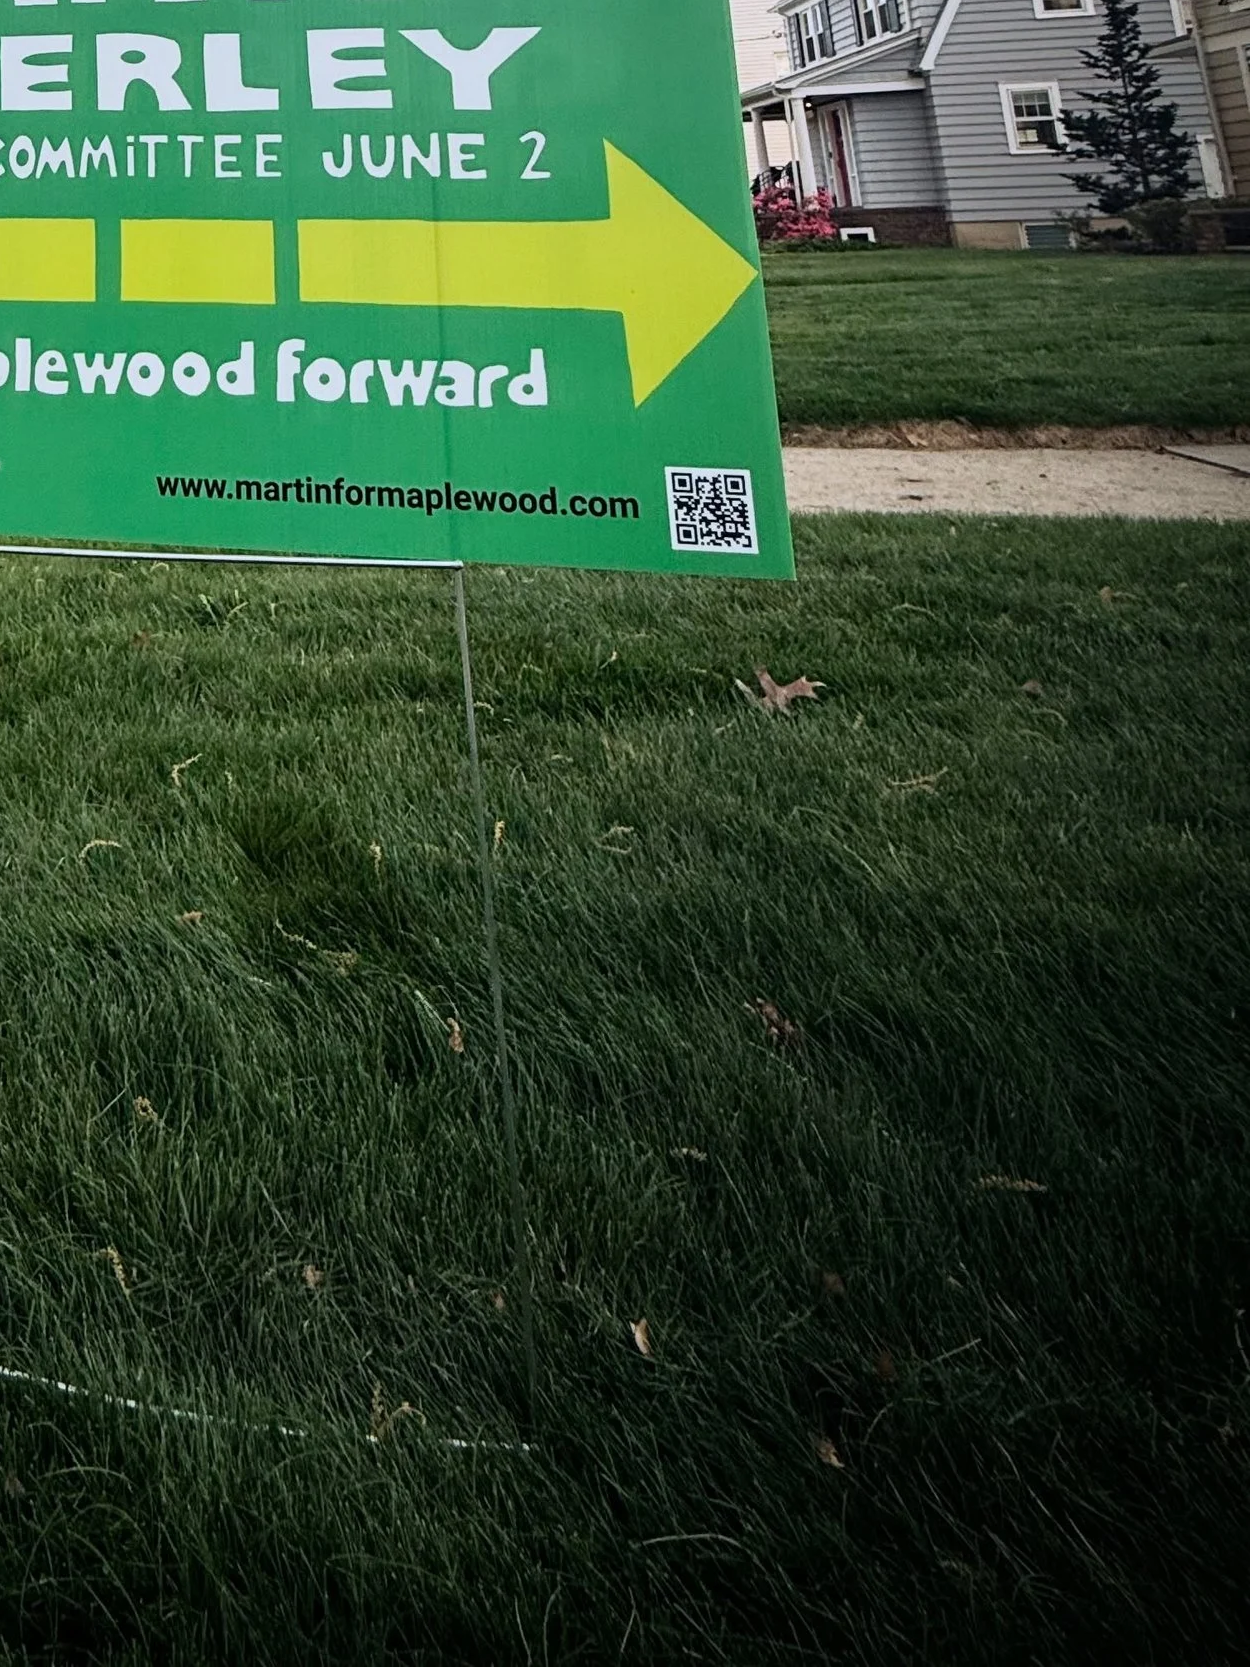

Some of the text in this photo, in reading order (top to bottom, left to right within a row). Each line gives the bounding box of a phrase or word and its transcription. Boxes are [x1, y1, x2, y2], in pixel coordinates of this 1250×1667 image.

[322, 132, 487, 180] JUNE
[519, 130, 552, 180] 2
[276, 338, 548, 408] forward
[156, 474, 641, 519] www.martinformaplewood.com
